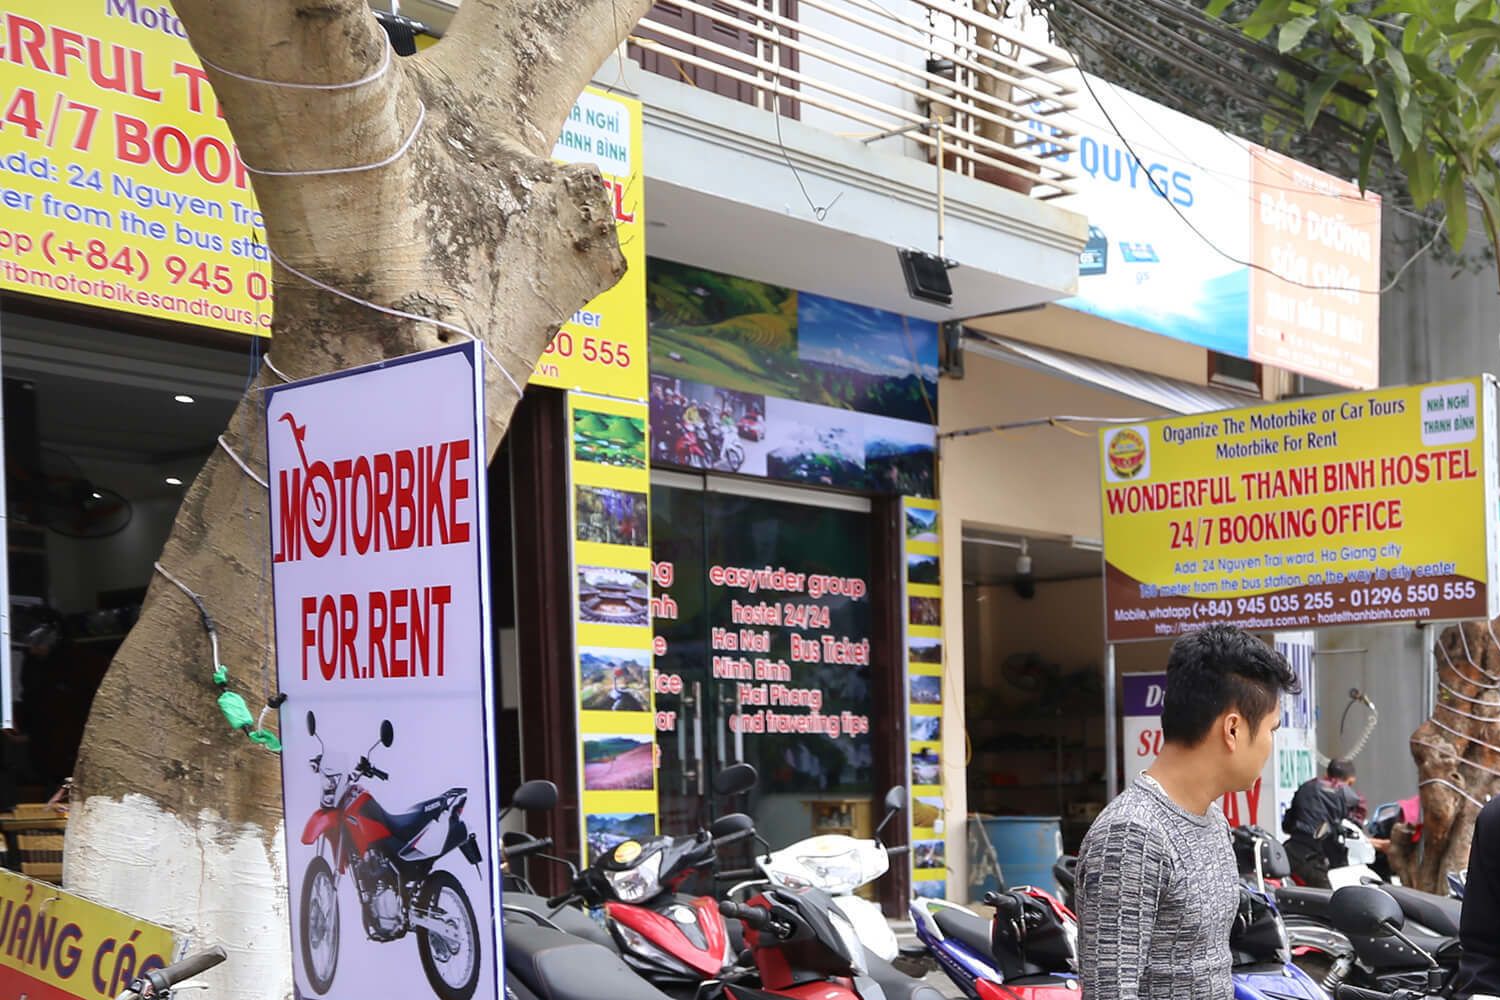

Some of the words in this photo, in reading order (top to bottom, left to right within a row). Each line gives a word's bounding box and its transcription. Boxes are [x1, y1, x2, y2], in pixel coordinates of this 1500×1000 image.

[0, 13, 162, 102] RFUL
[0, 87, 99, 151] 4/7
[0, 151, 58, 182] dd:
[67, 164, 102, 191] 24
[113, 174, 223, 221] Nguyen
[1080, 136, 1139, 188] QUY
[1148, 163, 1193, 207] GS
[0, 187, 34, 211] er
[42, 193, 112, 229] from
[121, 210, 167, 240] the
[176, 221, 223, 252] bus
[41, 230, 150, 282] (+84)
[164, 254, 234, 296] 945
[247, 271, 273, 302] 0
[0, 262, 272, 328] tbmotorbikesandtours.c
[583, 337, 631, 368] 555
[1163, 420, 1218, 446] Organize
[1222, 417, 1246, 435] The
[1250, 409, 1317, 431] Motorbike
[1322, 408, 1336, 422] or
[1340, 402, 1364, 420] Car
[1368, 398, 1405, 417] Tours
[1216, 439, 1278, 460] Motorbike
[1284, 434, 1302, 451] For
[1307, 431, 1338, 449] Rent
[273, 437, 470, 563] MOTORBIKE
[1106, 476, 1237, 516] WONDERFUL
[1242, 466, 1317, 502] THANH
[1323, 459, 1375, 493] BINH
[1381, 448, 1478, 487] HOSTEL
[1169, 517, 1214, 549] 24/7
[1219, 508, 1317, 545] BOOKING
[1322, 500, 1403, 536] OFFICE
[1194, 581, 1218, 593] from
[1221, 578, 1239, 591] the
[1242, 578, 1261, 590] bus
[1308, 574, 1322, 586] on
[1325, 570, 1344, 584] the
[1347, 571, 1372, 584] way
[1375, 567, 1387, 580] to
[1390, 566, 1412, 582] city
[1416, 562, 1456, 577] center
[1203, 559, 1215, 572] 24
[1218, 558, 1261, 573] Nguyen
[1264, 554, 1283, 566] Trai
[1321, 549, 1337, 562] Ha
[1341, 546, 1377, 562] Giang
[1380, 543, 1402, 559] city
[709, 565, 806, 593] easyrider
[808, 573, 866, 601] group
[1192, 600, 1233, 620] (+84)
[1237, 596, 1266, 615] 945
[1270, 594, 1300, 612] 035
[1304, 592, 1334, 611] 255
[1350, 586, 1403, 606] 01296
[1407, 583, 1439, 602] 550
[1443, 581, 1476, 600] 555
[301, 585, 452, 681] FOR.RENT
[731, 599, 782, 626] hostel
[784, 603, 831, 630] 24/24
[711, 627, 738, 650] Ha
[740, 629, 770, 653] Noi
[790, 633, 820, 663] Bus
[821, 634, 870, 666] Ticket
[712, 656, 752, 679] Ninh
[755, 657, 791, 681] Binh
[739, 682, 768, 706] Hai
[770, 684, 822, 711] Phong
[729, 710, 765, 733] and
[841, 711, 869, 738] tips
